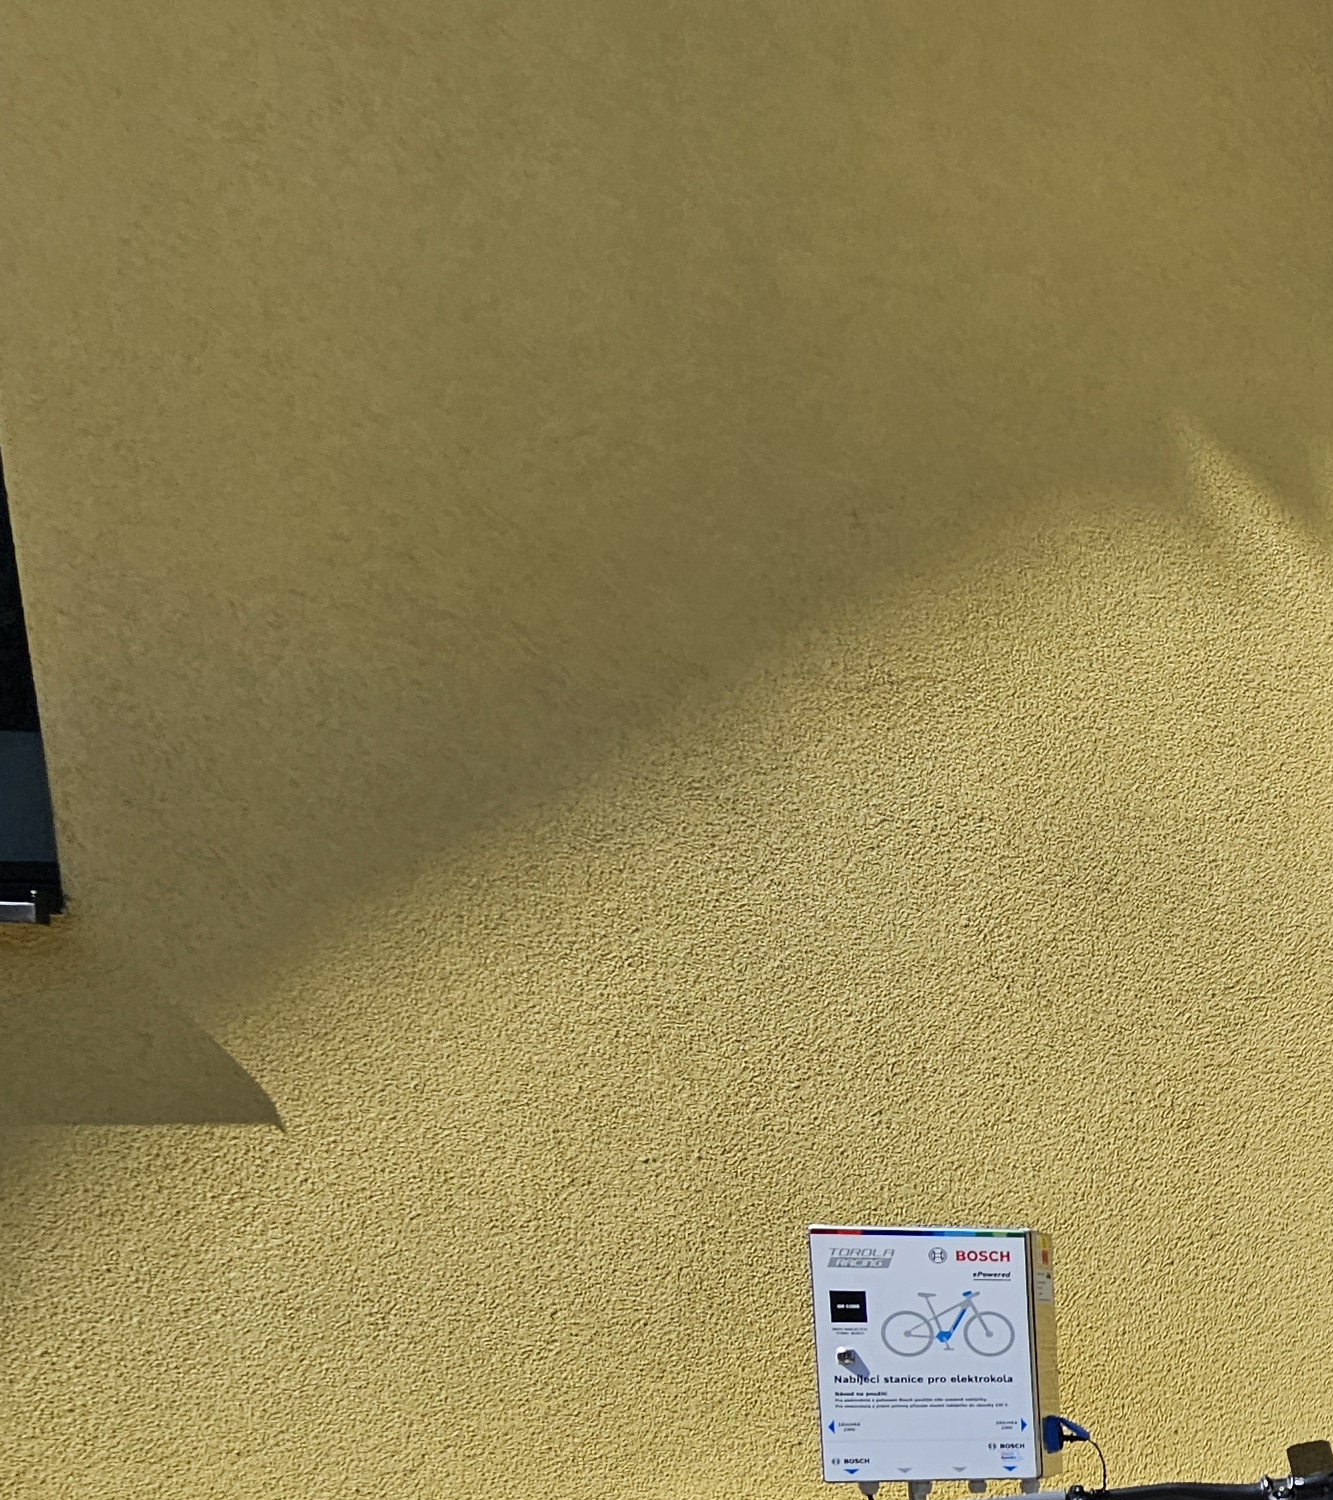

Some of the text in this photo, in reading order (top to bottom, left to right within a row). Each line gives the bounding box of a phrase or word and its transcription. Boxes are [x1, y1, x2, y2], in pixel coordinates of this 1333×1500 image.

[829, 1247, 1011, 1262] TOROLA BOSCH
[835, 1258, 883, 1267] RACING
[972, 1271, 1011, 1279] ePowered
[883, 1374, 924, 1384] stanice
[927, 1376, 947, 1385] pro
[950, 1374, 1014, 1384] elektrokola
